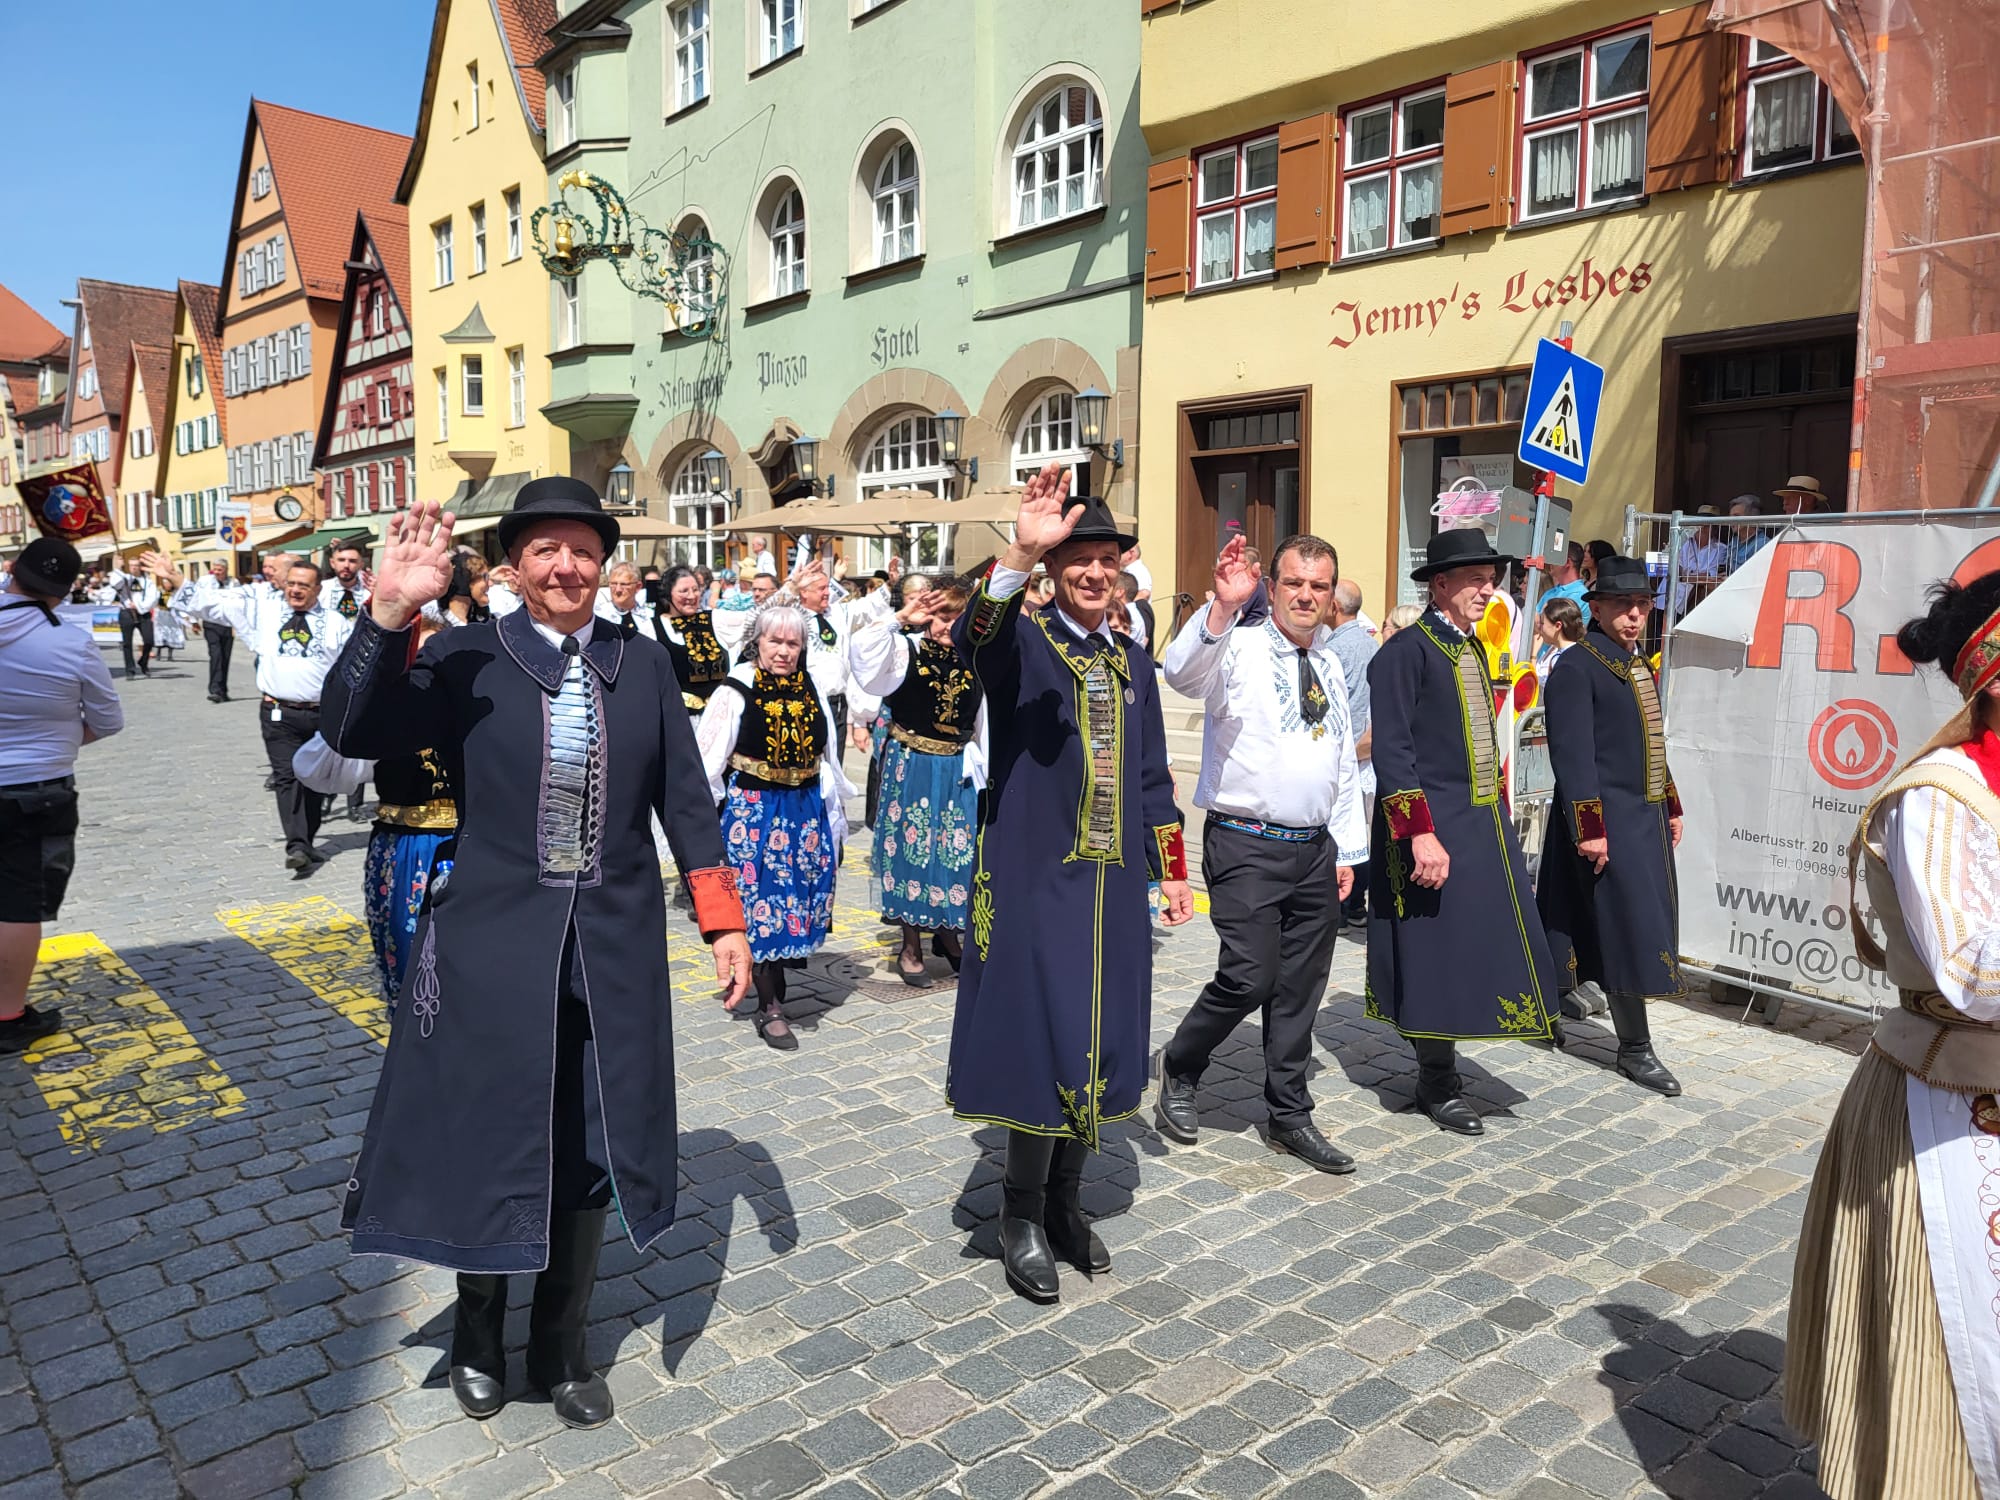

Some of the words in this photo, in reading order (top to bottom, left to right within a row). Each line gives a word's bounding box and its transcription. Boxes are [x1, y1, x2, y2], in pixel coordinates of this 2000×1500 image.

[1328, 282, 1481, 349] Jenny's
[1498, 256, 1653, 313] Lashes
[757, 352, 808, 395] Piazza
[870, 319, 921, 369] Hotel
[1812, 795, 1868, 815] Heizun
[1730, 828, 1808, 851] Albertusstr.
[1812, 840, 1829, 854] 20
[1837, 844, 1850, 858] 8
